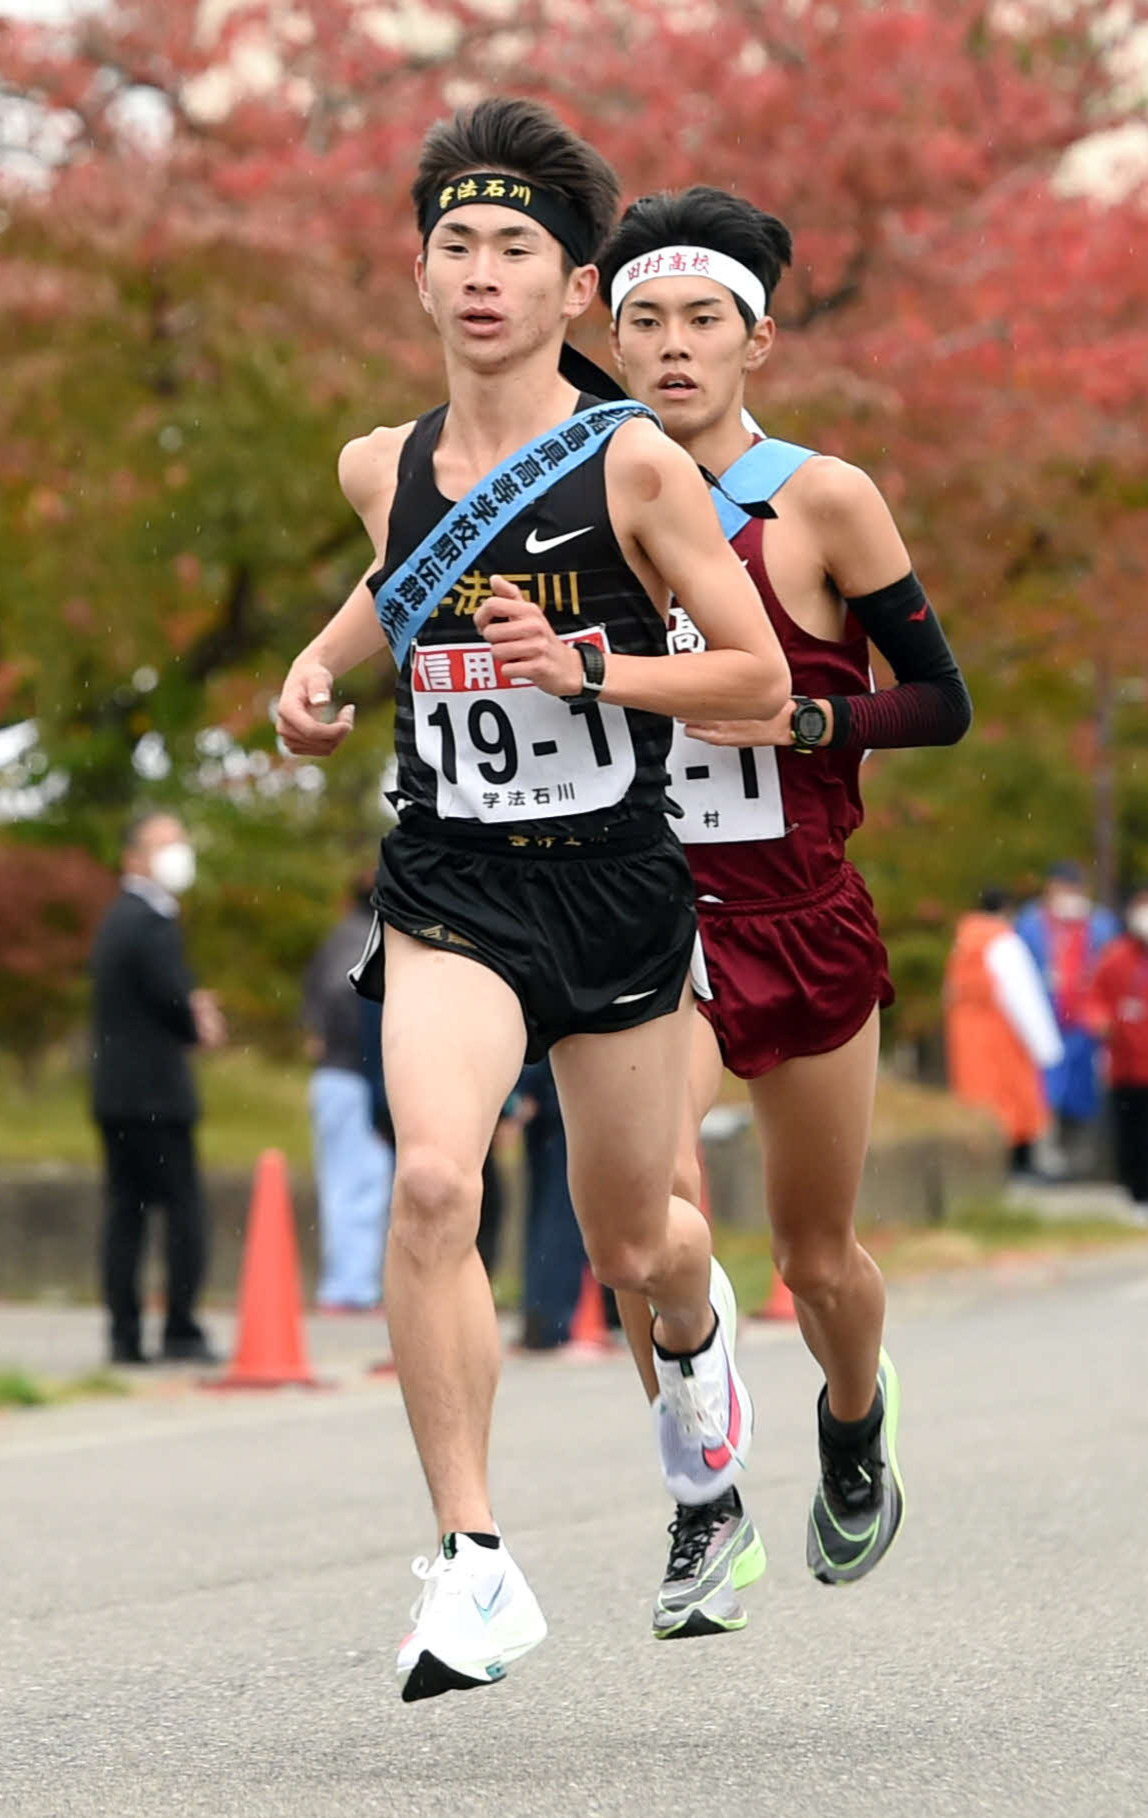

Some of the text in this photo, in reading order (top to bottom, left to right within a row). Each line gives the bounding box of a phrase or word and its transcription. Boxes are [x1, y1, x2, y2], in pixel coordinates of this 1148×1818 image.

[627, 252, 710, 282] 田村高校
[428, 698, 613, 785] 19-1
[665, 747, 760, 799] -1
[482, 782, 576, 809] 学法石川
